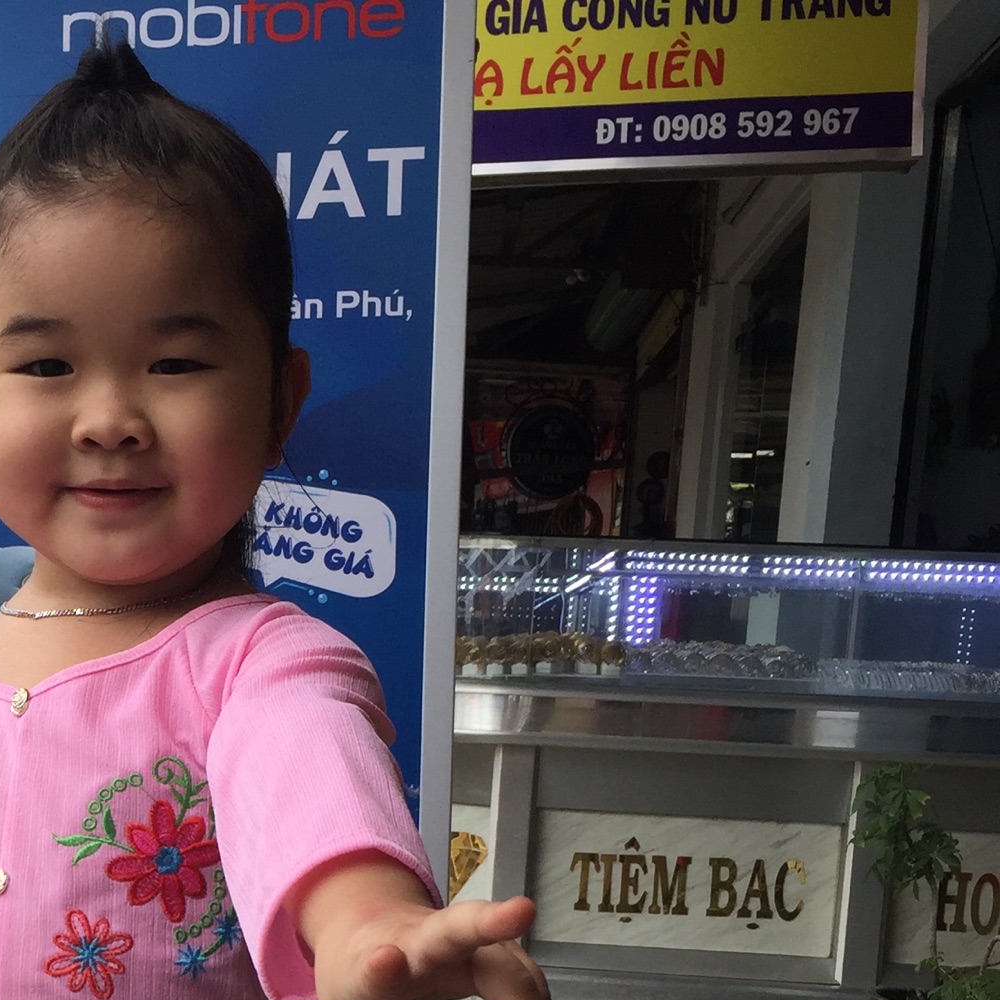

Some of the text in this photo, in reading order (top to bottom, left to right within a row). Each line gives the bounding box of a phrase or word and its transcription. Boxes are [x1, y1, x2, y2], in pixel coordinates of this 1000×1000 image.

[62, 0, 405, 52] mobifone
[485, 0, 547, 35] GIA
[520, 37, 606, 95] LẤY
[620, 31, 725, 91] LIỀN
[596, 107, 859, 144] ĐT: 0908 592 967
[336, 289, 413, 321] Phú,
[264, 500, 363, 543] KHÔNG
[324, 549, 375, 579] GIÁ
[570, 837, 806, 930] TIỆM BẠC
